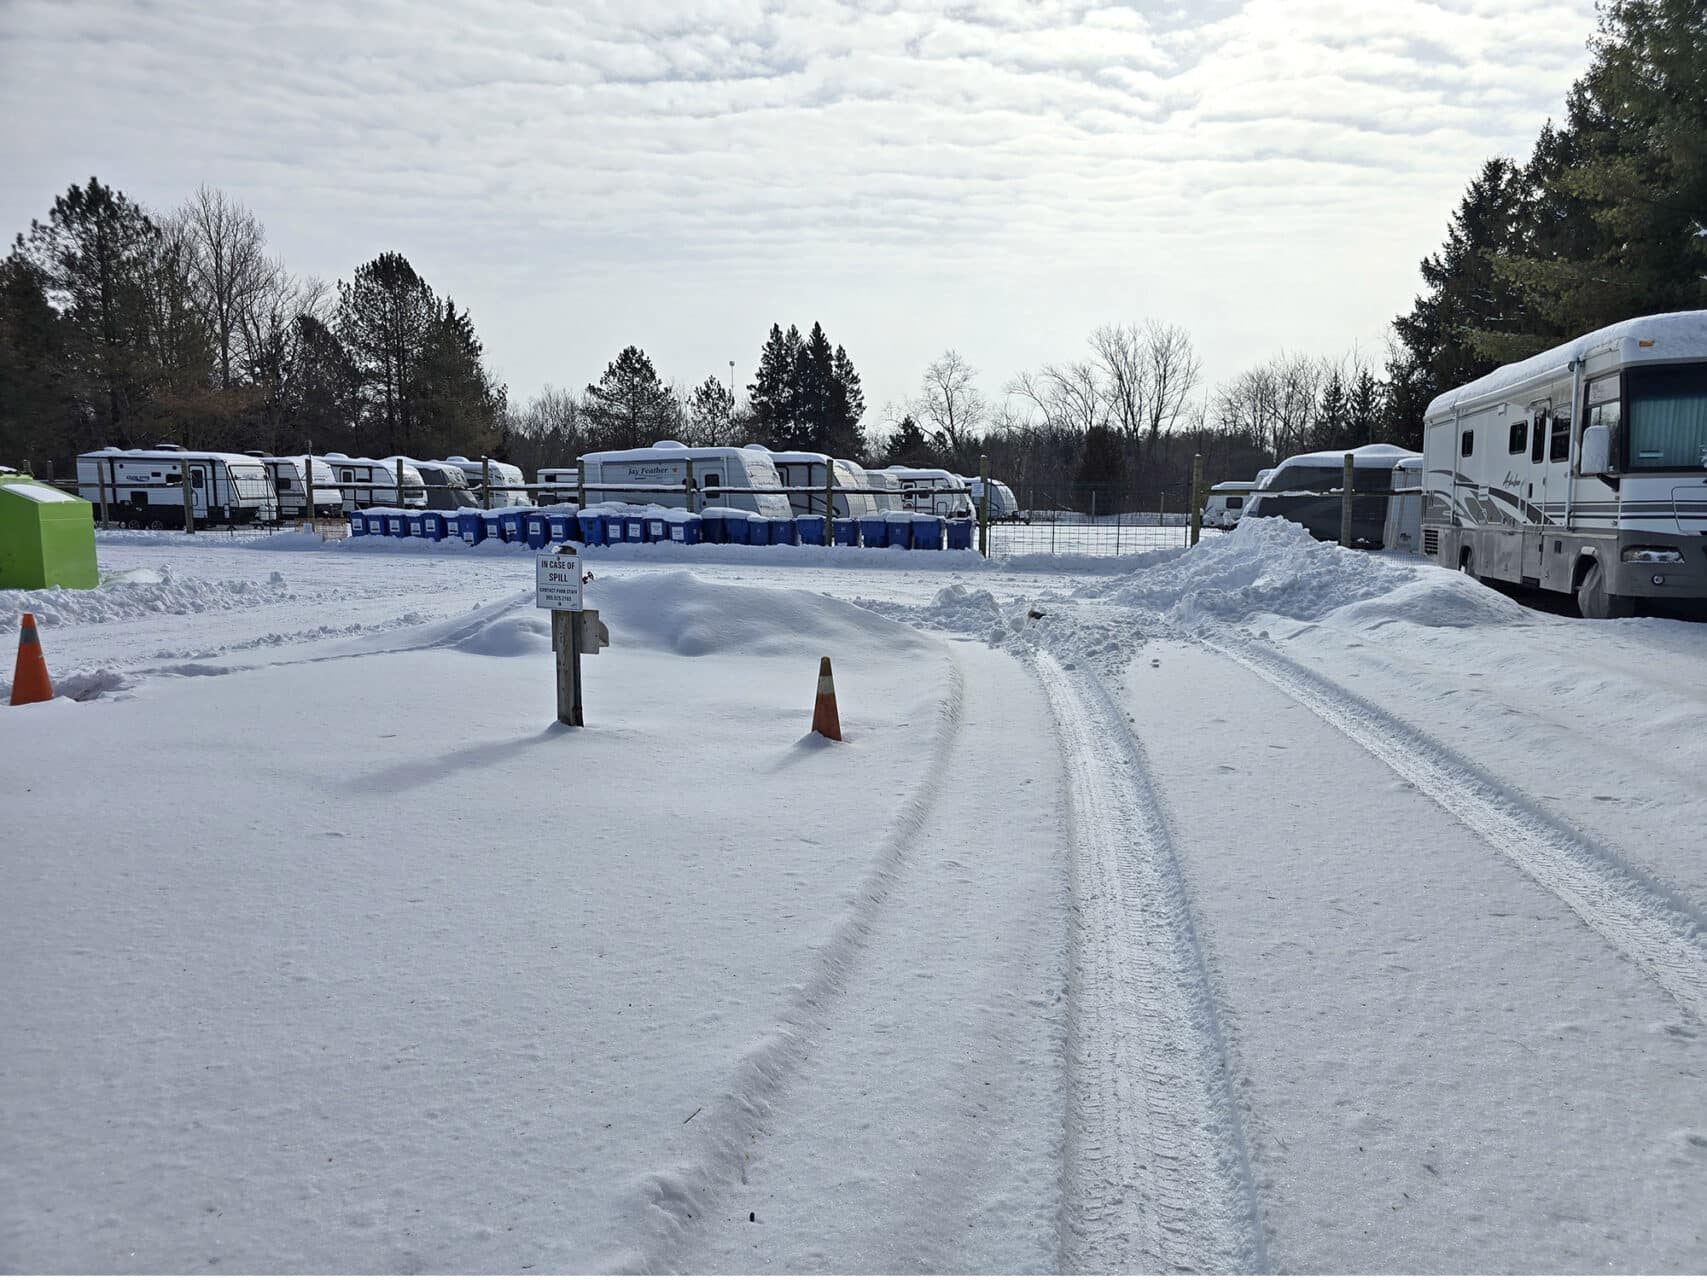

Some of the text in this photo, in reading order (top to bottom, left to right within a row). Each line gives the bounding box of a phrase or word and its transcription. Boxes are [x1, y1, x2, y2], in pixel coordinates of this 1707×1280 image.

[641, 466, 668, 474] Feather
[541, 560, 575, 570] IN CASE OF
[549, 573, 568, 582] SPILL
